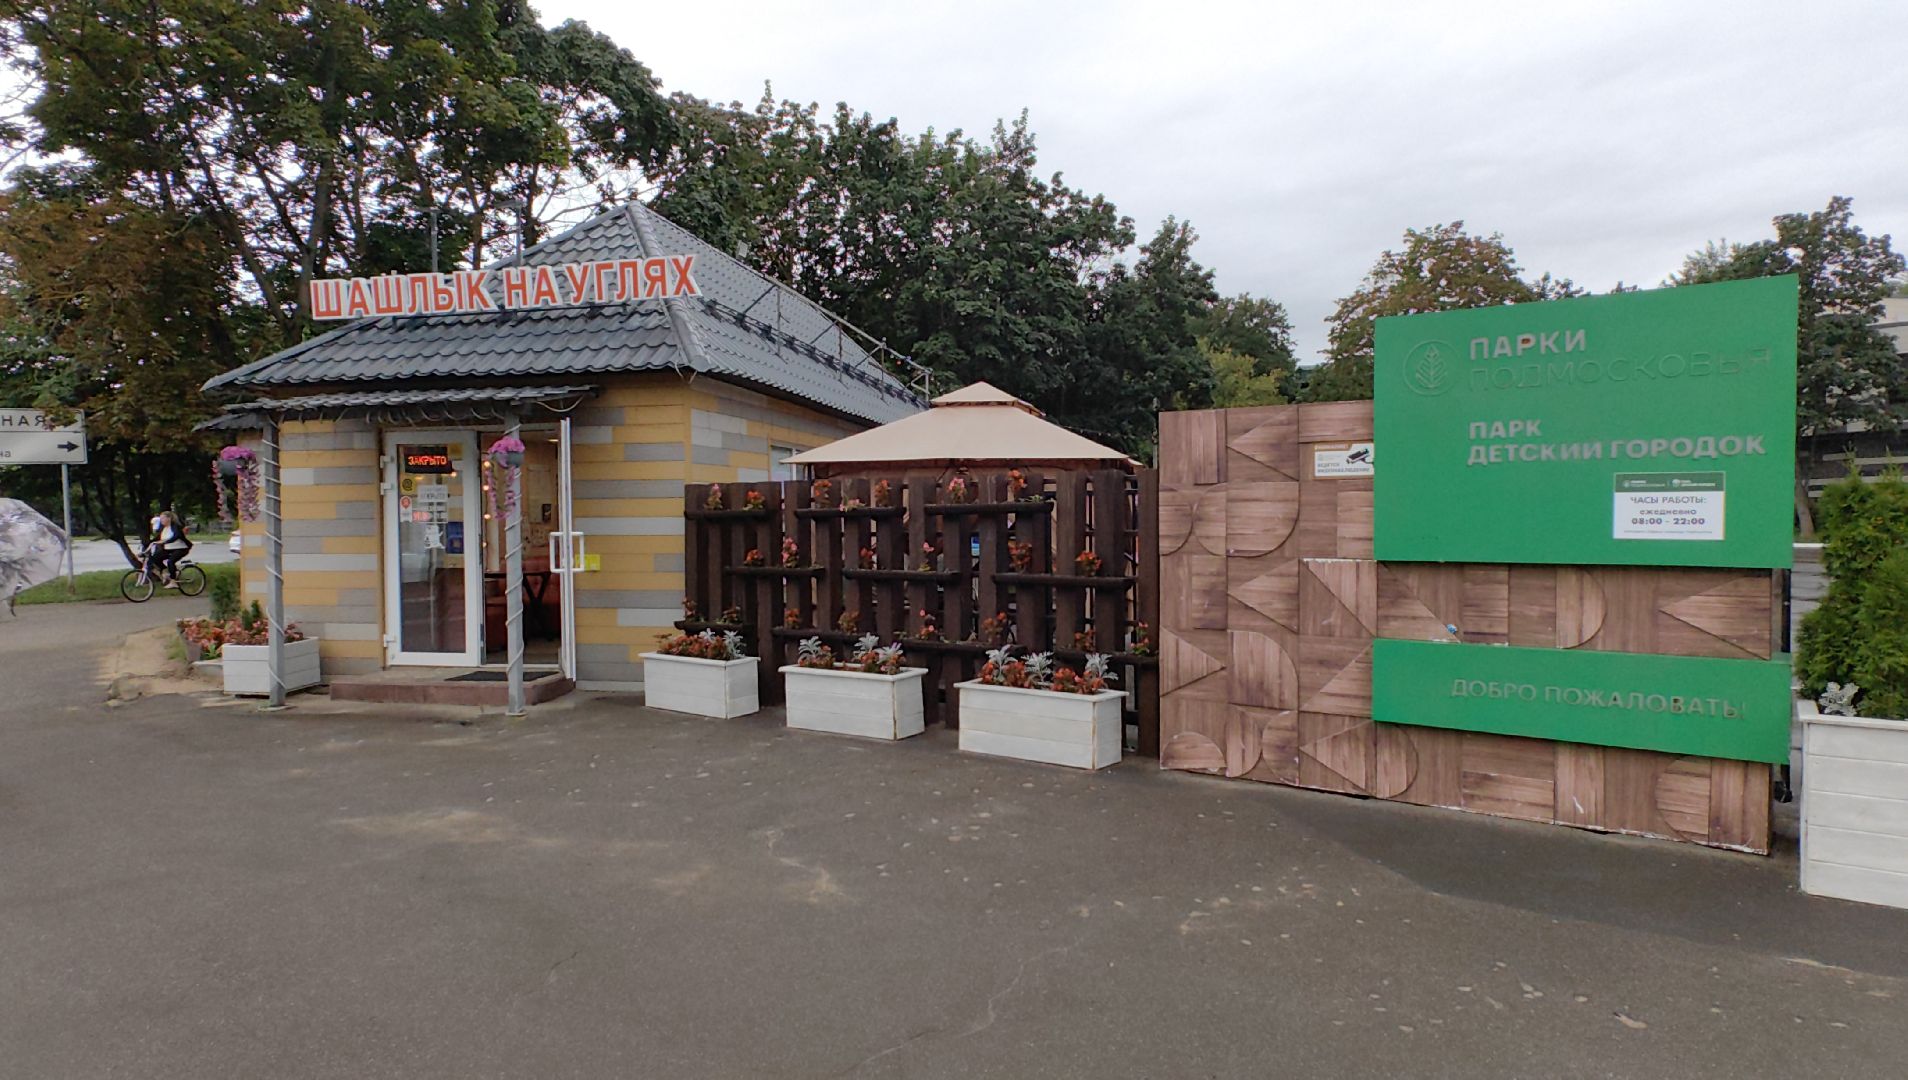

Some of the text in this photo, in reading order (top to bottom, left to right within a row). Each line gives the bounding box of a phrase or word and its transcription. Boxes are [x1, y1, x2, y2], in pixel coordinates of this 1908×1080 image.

[310, 254, 701, 320] ШАШЛЫК НА УГЛЯХ
[1470, 329, 1586, 360] ПАРКИ
[1470, 346, 1770, 391] ПОДМОСКОВЬЯ
[1469, 419, 1542, 440] ПАРК
[1609, 435, 1766, 460] ГОРОДОК
[407, 456, 447, 466] ЗАКРЫТО
[1630, 496, 1707, 504] ЧАСЫ РАБОТЫ:
[1631, 517, 1662, 525] 08:00
[1673, 517, 1705, 525] 22:00
[1450, 678, 1537, 701] ДОБРО
